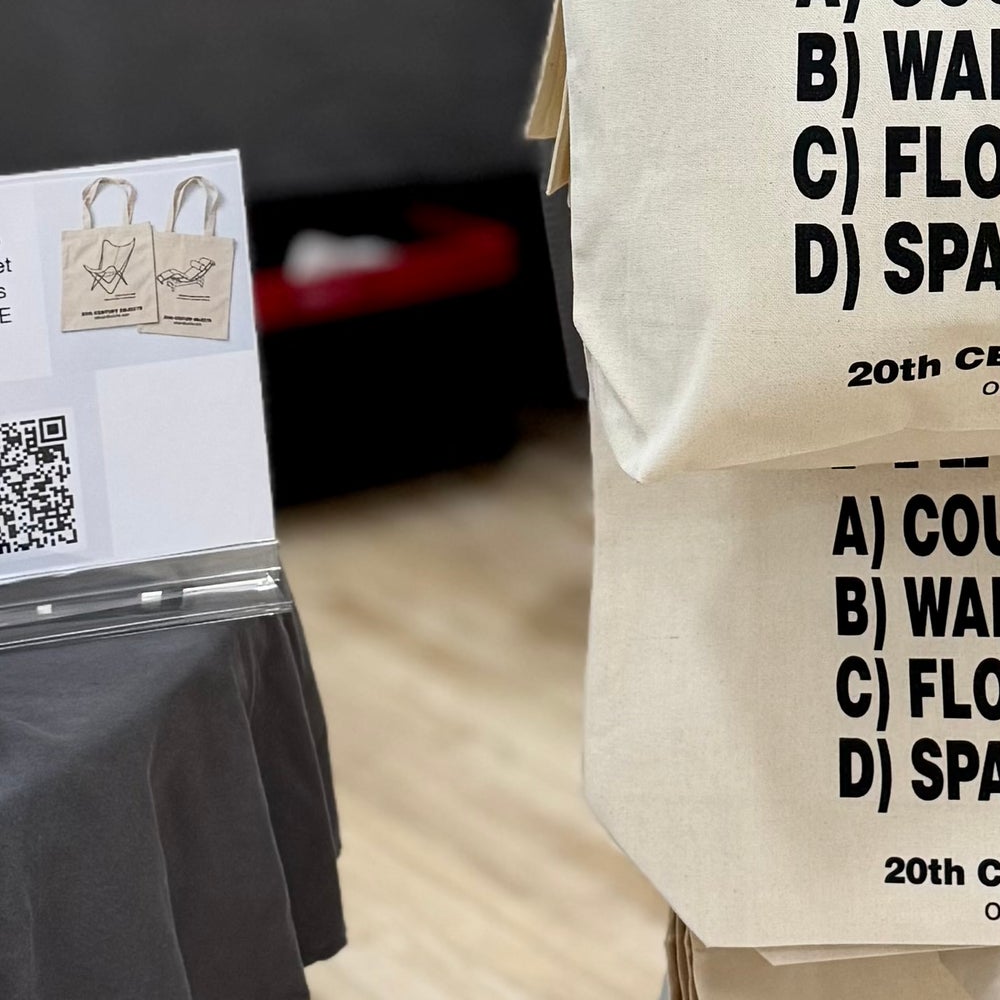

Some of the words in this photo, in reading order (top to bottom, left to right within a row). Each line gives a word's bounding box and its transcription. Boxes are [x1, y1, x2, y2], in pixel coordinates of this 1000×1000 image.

[796, 31, 861, 119] B)
[792, 125, 860, 216] C)
[794, 223, 861, 311] D)
[847, 354, 942, 388] 20th
[831, 495, 886, 570] A)
[835, 576, 887, 651] B)
[835, 655, 890, 732] C)
[838, 737, 893, 814] D)
[884, 856, 965, 886] 20th
